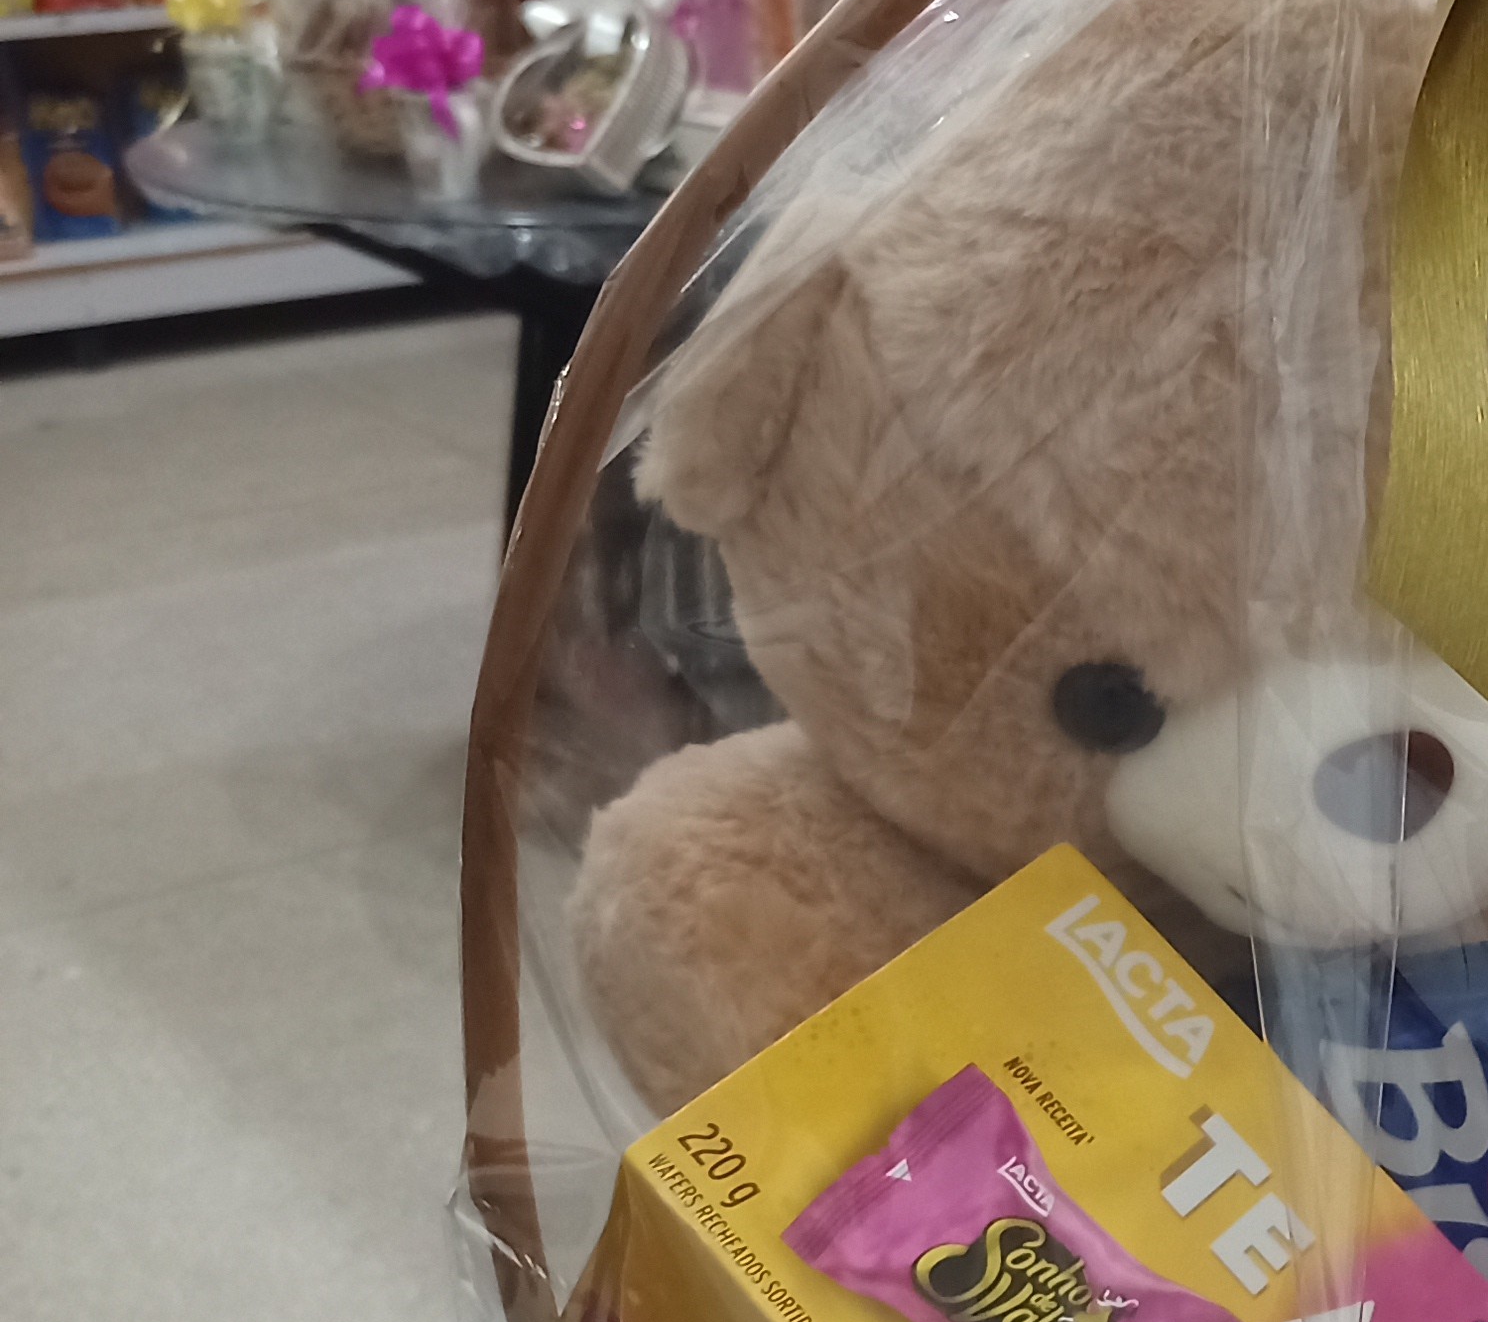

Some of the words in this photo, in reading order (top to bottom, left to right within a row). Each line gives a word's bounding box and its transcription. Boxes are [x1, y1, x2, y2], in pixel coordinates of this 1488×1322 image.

[1044, 894, 1215, 1079] LACTA
[1003, 1056, 1042, 1095] NOVA
[677, 1122, 747, 1181] 220
[998, 1156, 1055, 1217] LACTA
[648, 1152, 699, 1210] WAFERS
[695, 1198, 772, 1286] RECHEADOS
[1161, 1112, 1316, 1295] TE
[915, 1218, 1093, 1306] Sonho
